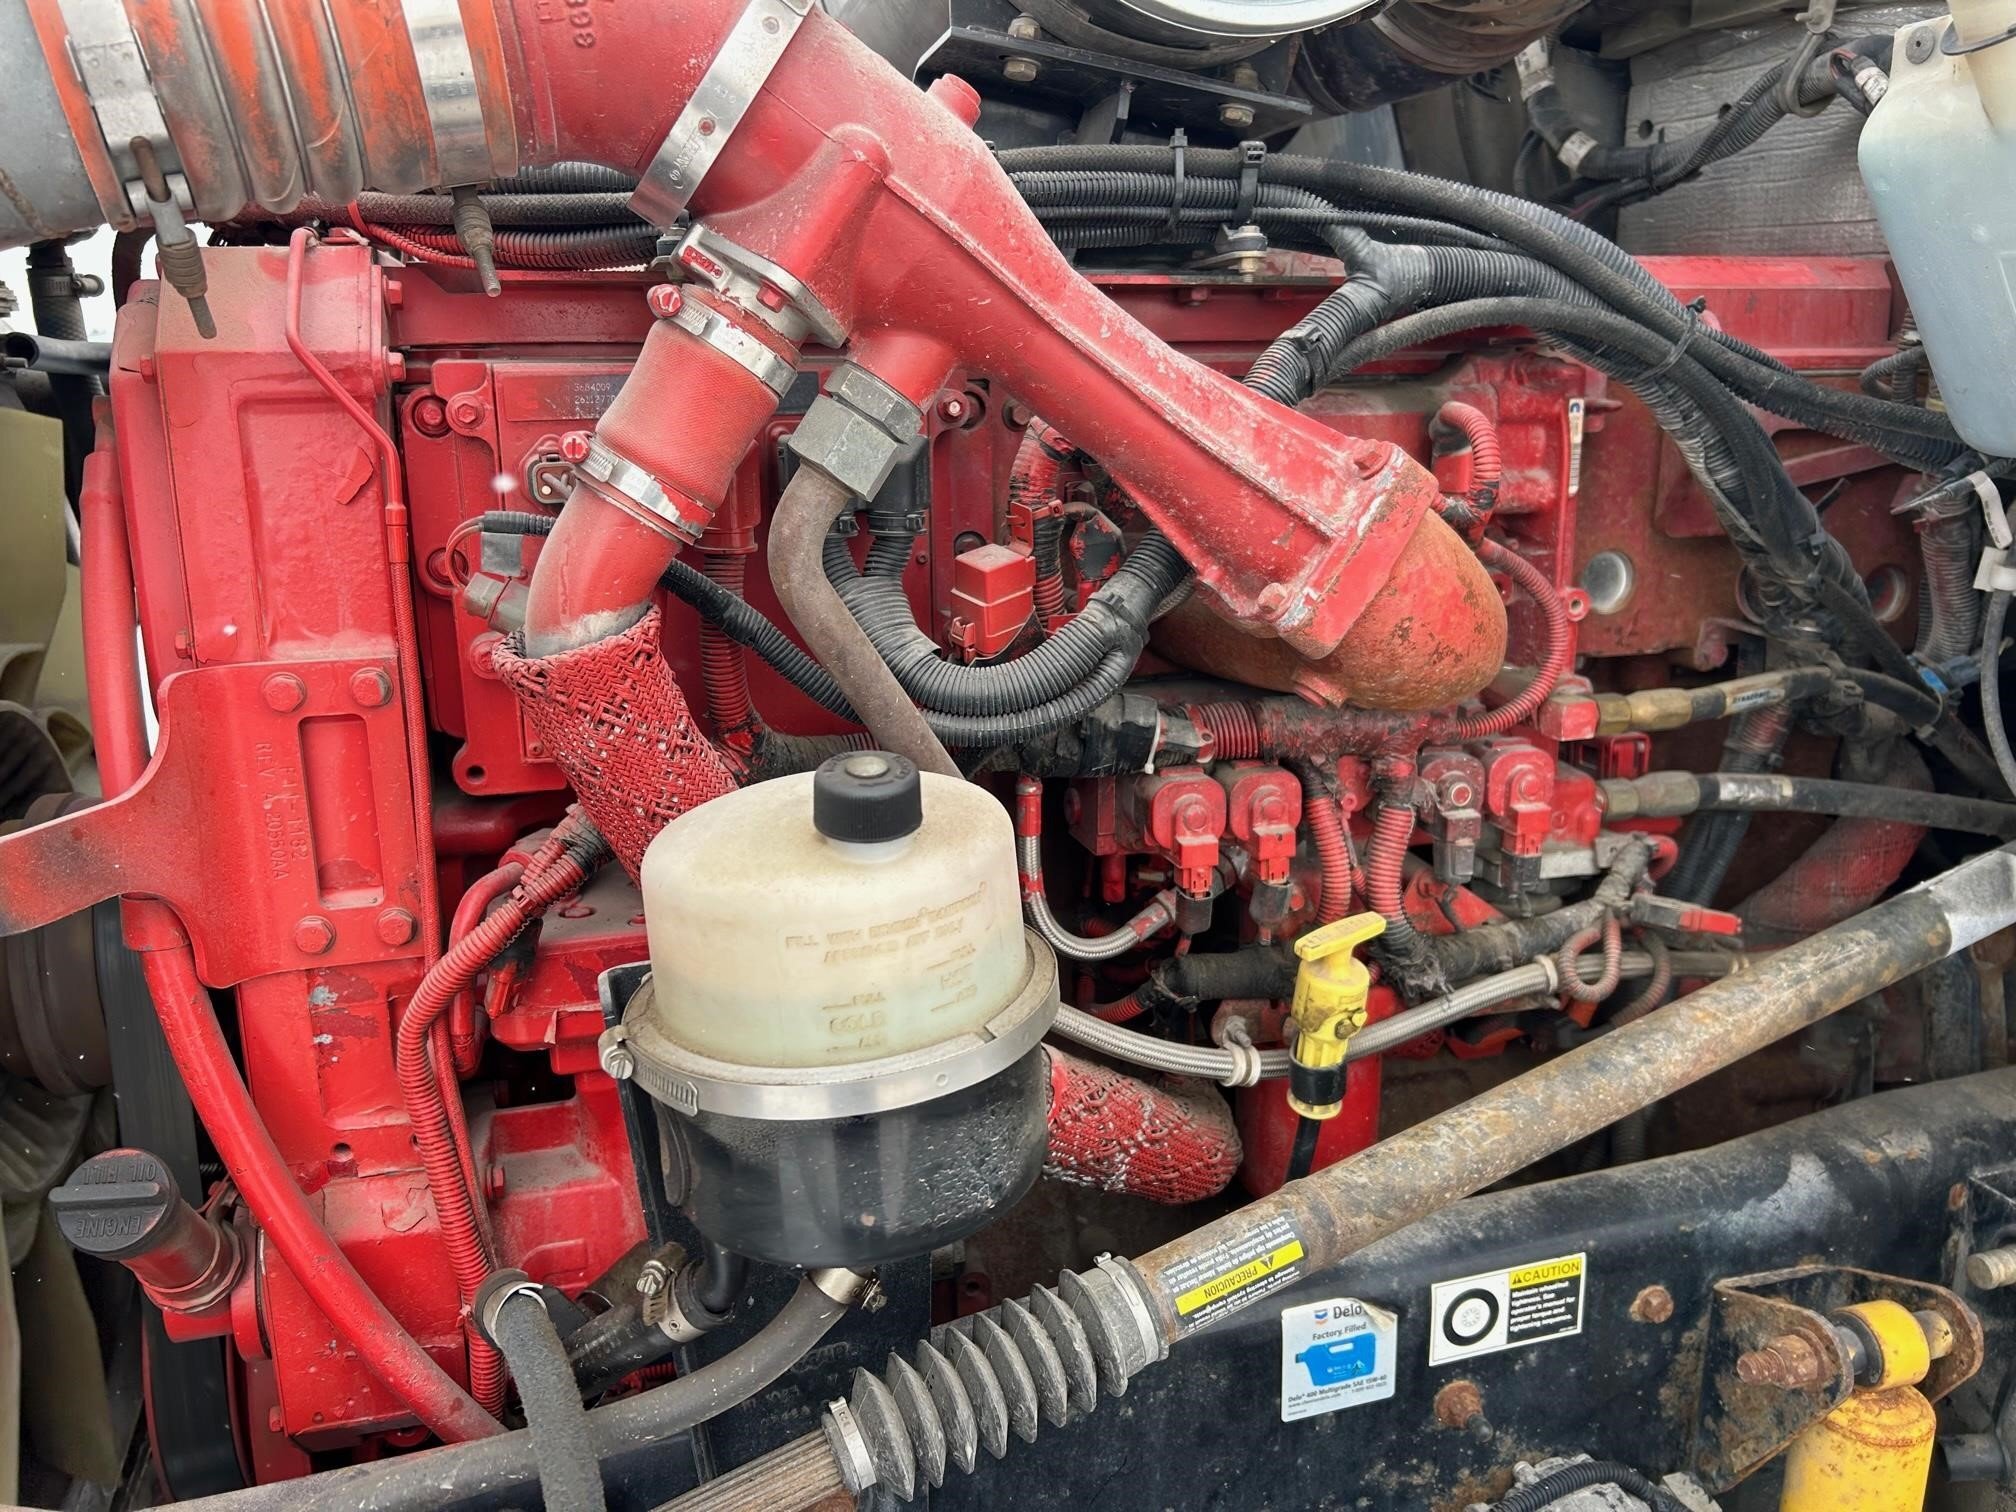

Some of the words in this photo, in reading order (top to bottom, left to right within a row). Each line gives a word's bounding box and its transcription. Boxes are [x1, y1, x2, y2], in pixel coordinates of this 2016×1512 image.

[80, 1163, 120, 1186] FILL
[129, 1162, 157, 1183] OIL
[74, 1214, 144, 1239] ENGINE
[1202, 1265, 1258, 1297] PRECAUCION
[1522, 1261, 1579, 1282] CAUTION
[1333, 1303, 1362, 1319] Delo
[1311, 1328, 1343, 1341] Factory
[1343, 1321, 1367, 1333] Filled
